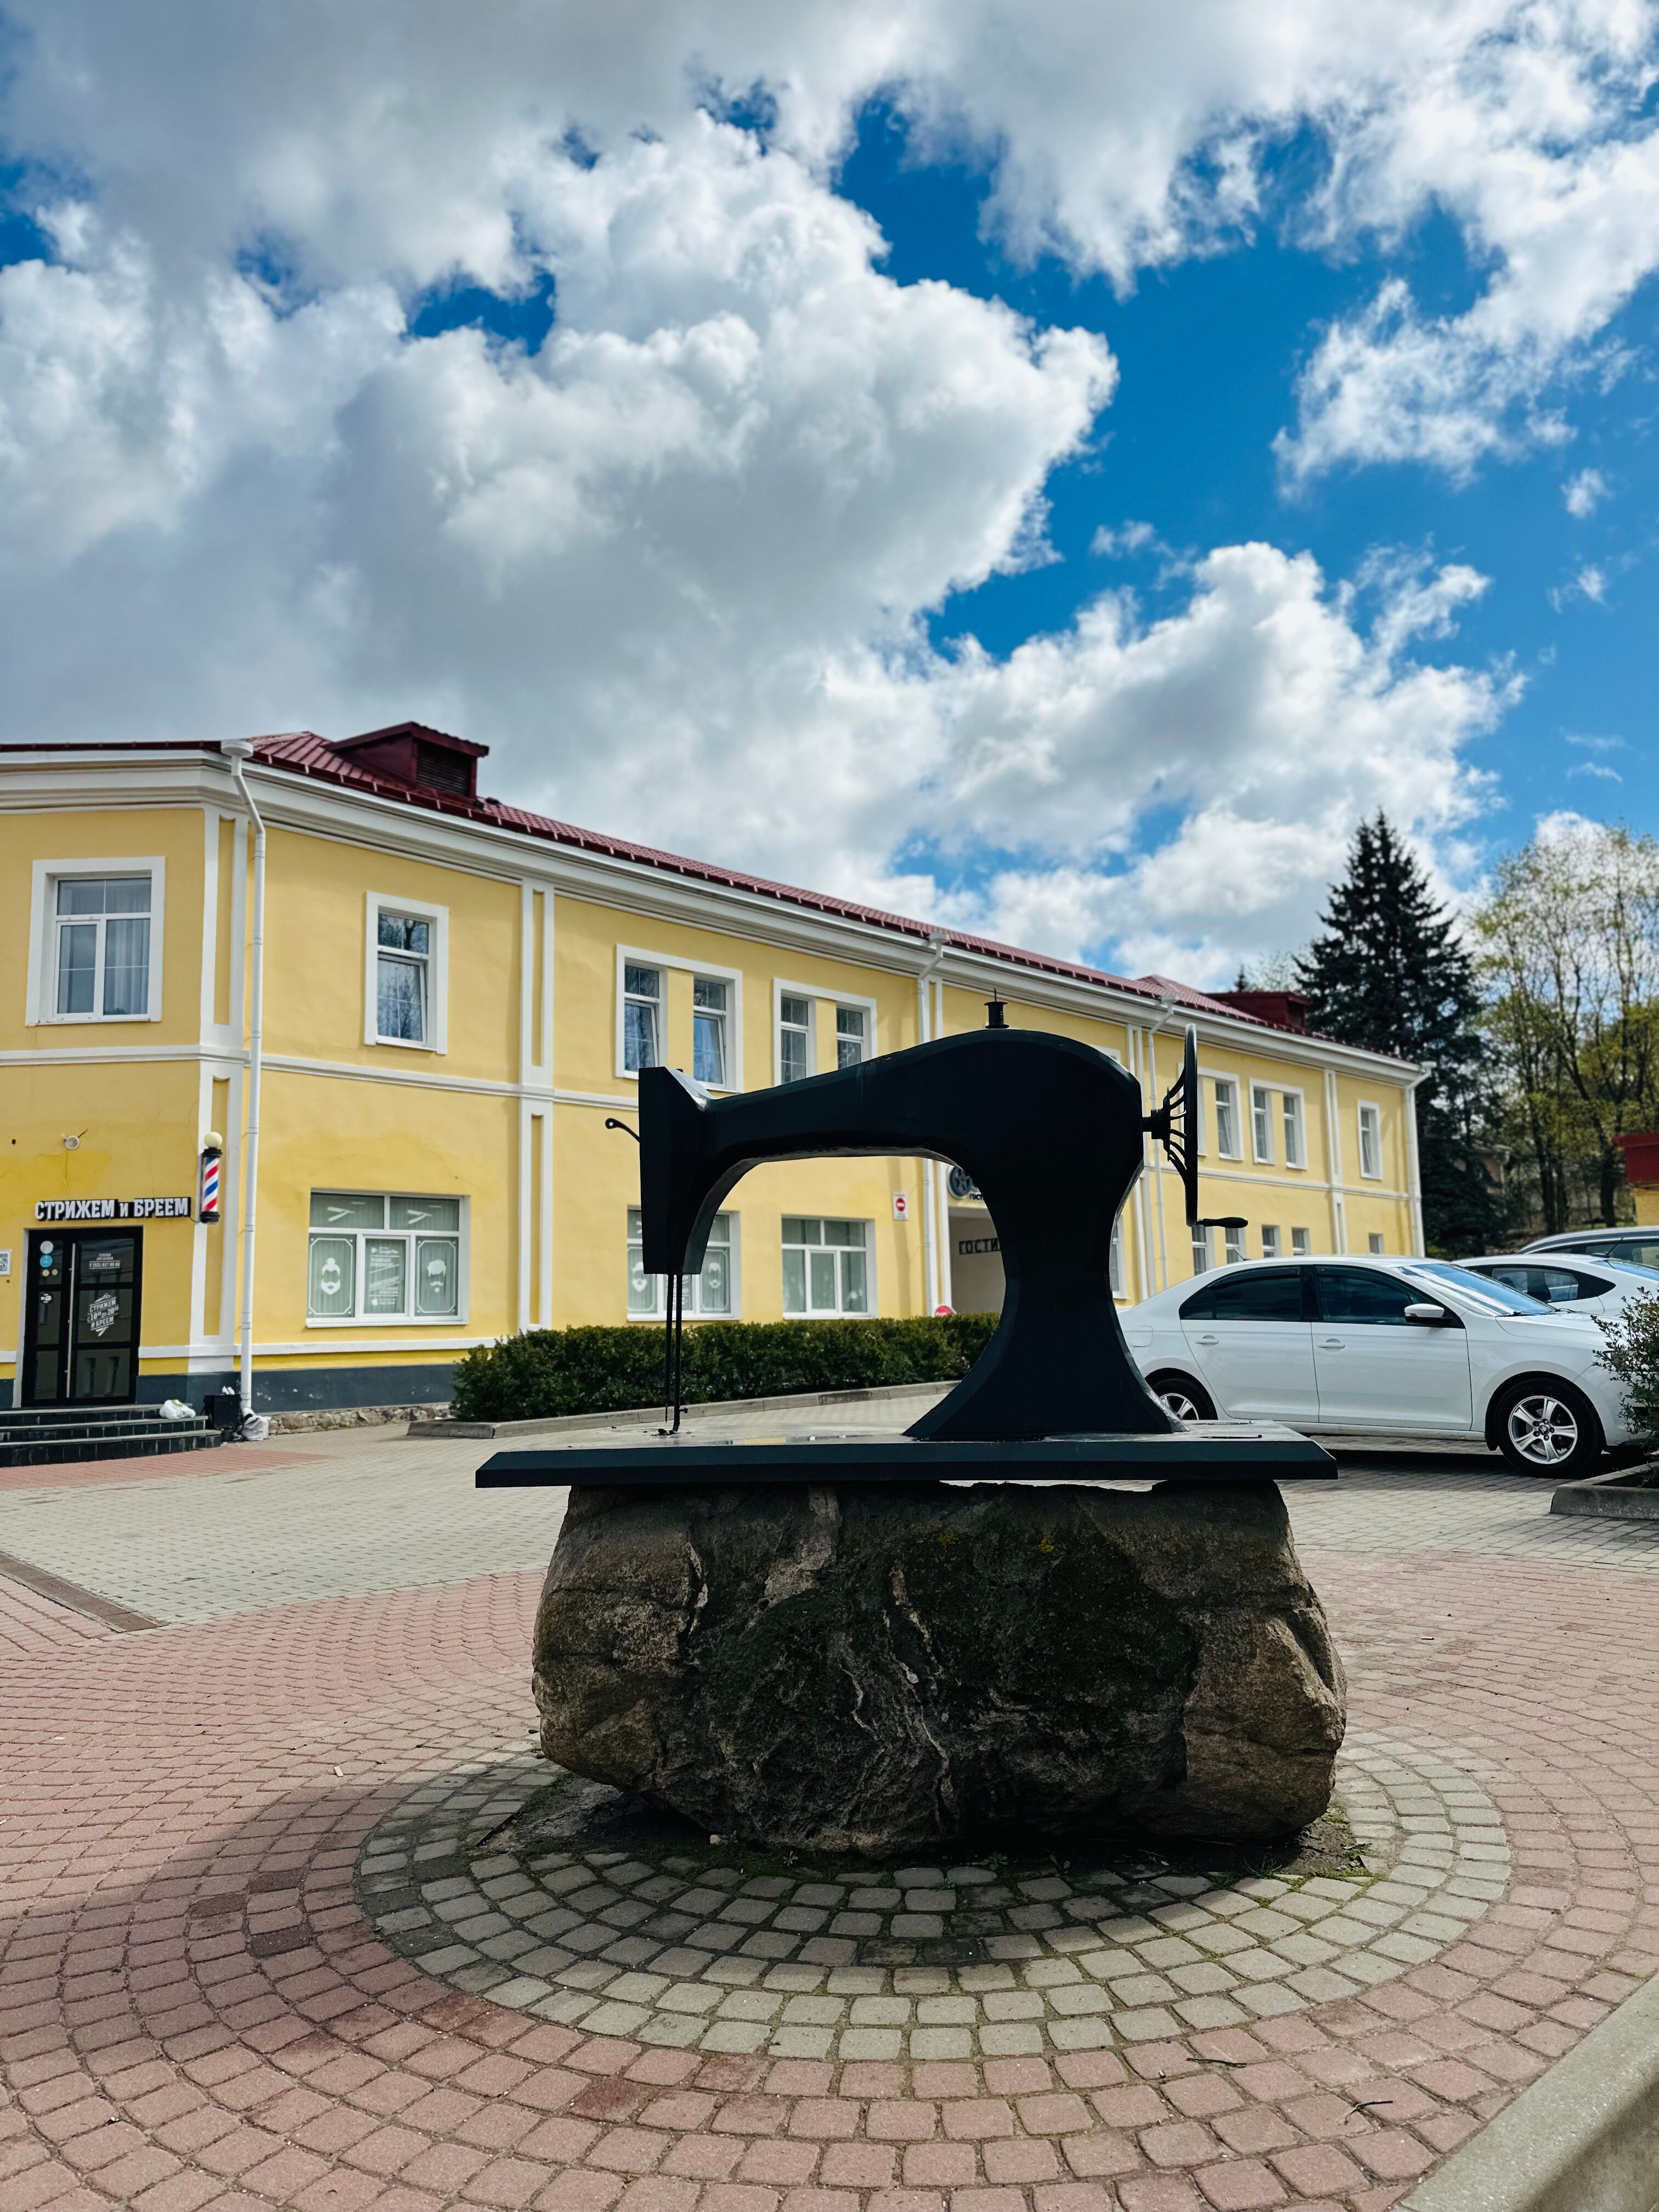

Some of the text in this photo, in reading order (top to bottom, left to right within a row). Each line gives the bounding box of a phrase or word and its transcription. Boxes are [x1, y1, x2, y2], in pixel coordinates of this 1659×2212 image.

[35, 1199, 115, 1220] СТРИЖЕМ
[134, 1198, 188, 1217] БРЕЕМ
[89, 1299, 116, 1313] СТРИЖЕМ
[95, 1316, 114, 1327] БРЕЕМ
